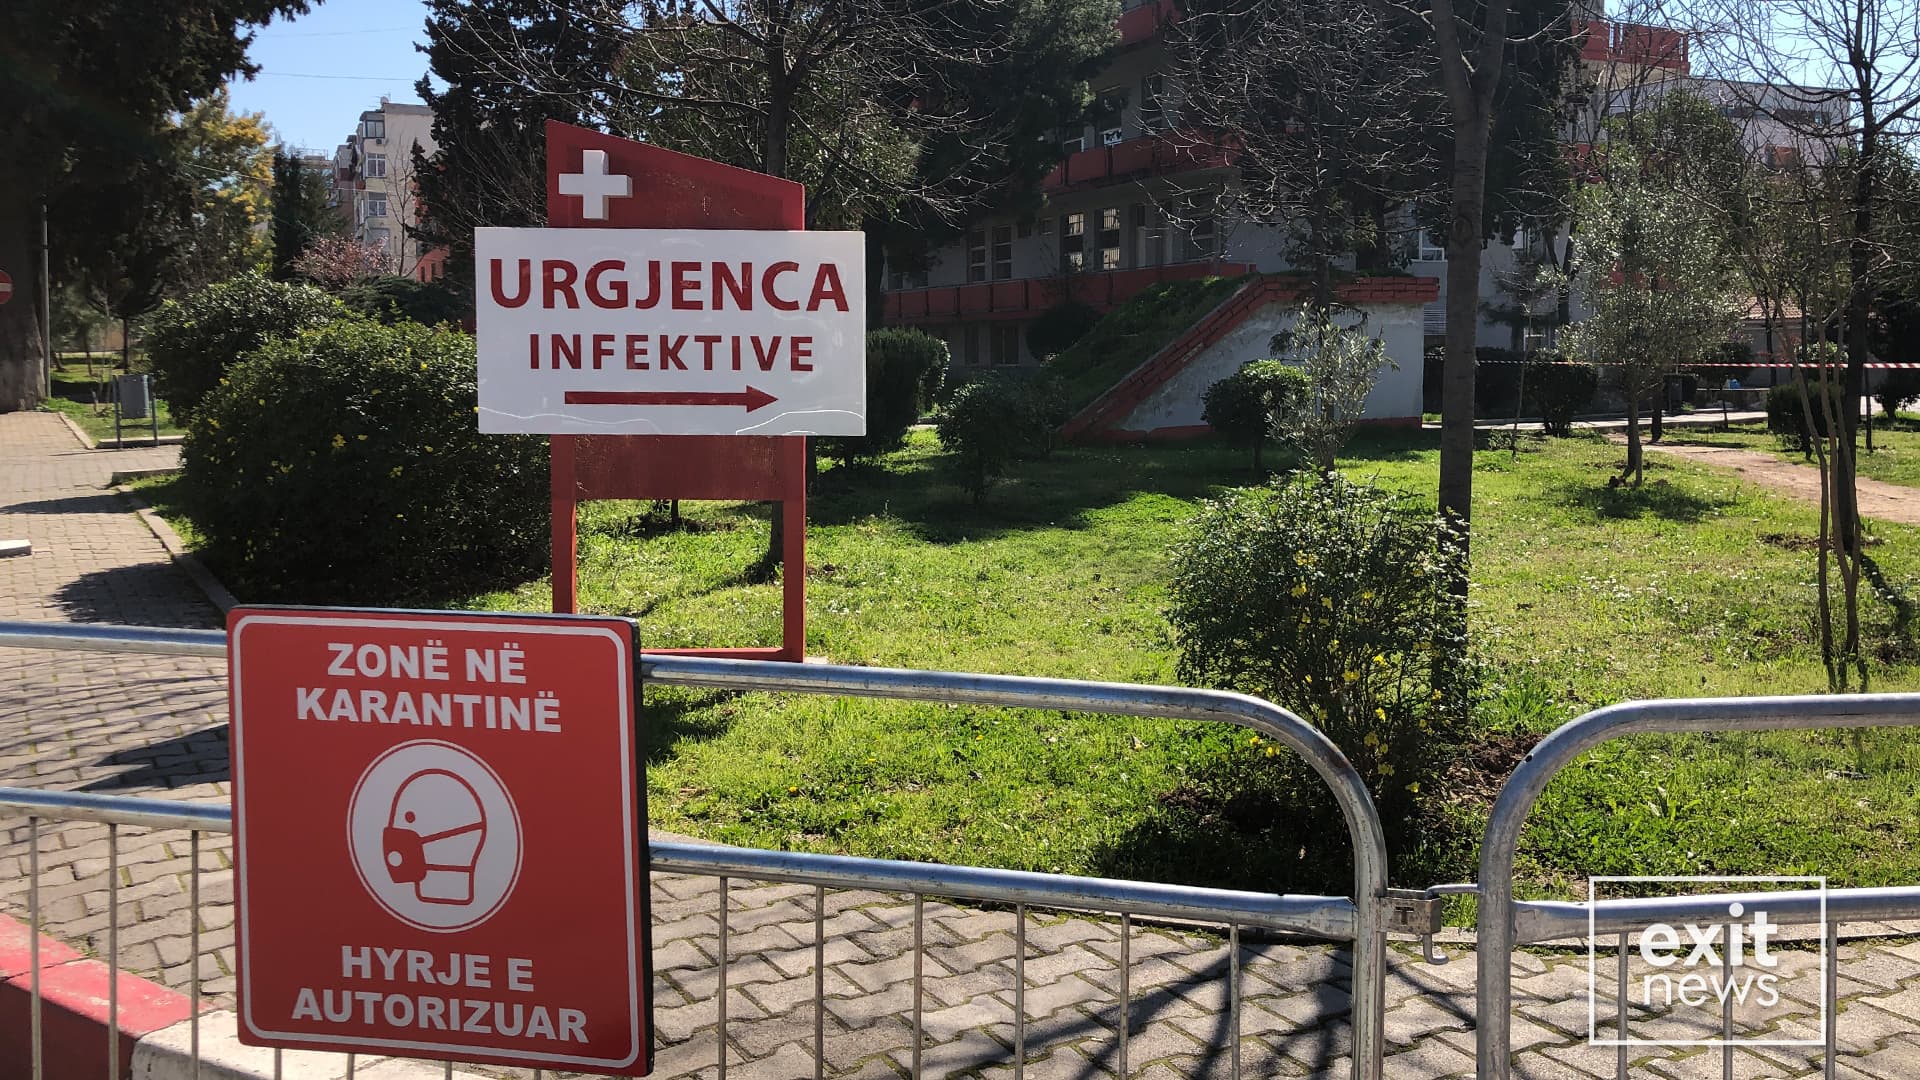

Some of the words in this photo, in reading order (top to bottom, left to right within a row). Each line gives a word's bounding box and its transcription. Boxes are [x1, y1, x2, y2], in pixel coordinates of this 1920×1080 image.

[491, 259, 848, 311] URGJENCA
[531, 334, 812, 371] INFEKTIVE
[328, 640, 450, 681] ZONË
[465, 642, 526, 684] NË
[296, 688, 562, 733] KARANTINË
[342, 945, 492, 989] HYRJE
[508, 958, 534, 992] E
[292, 988, 589, 1044] AUTORIZUAR
